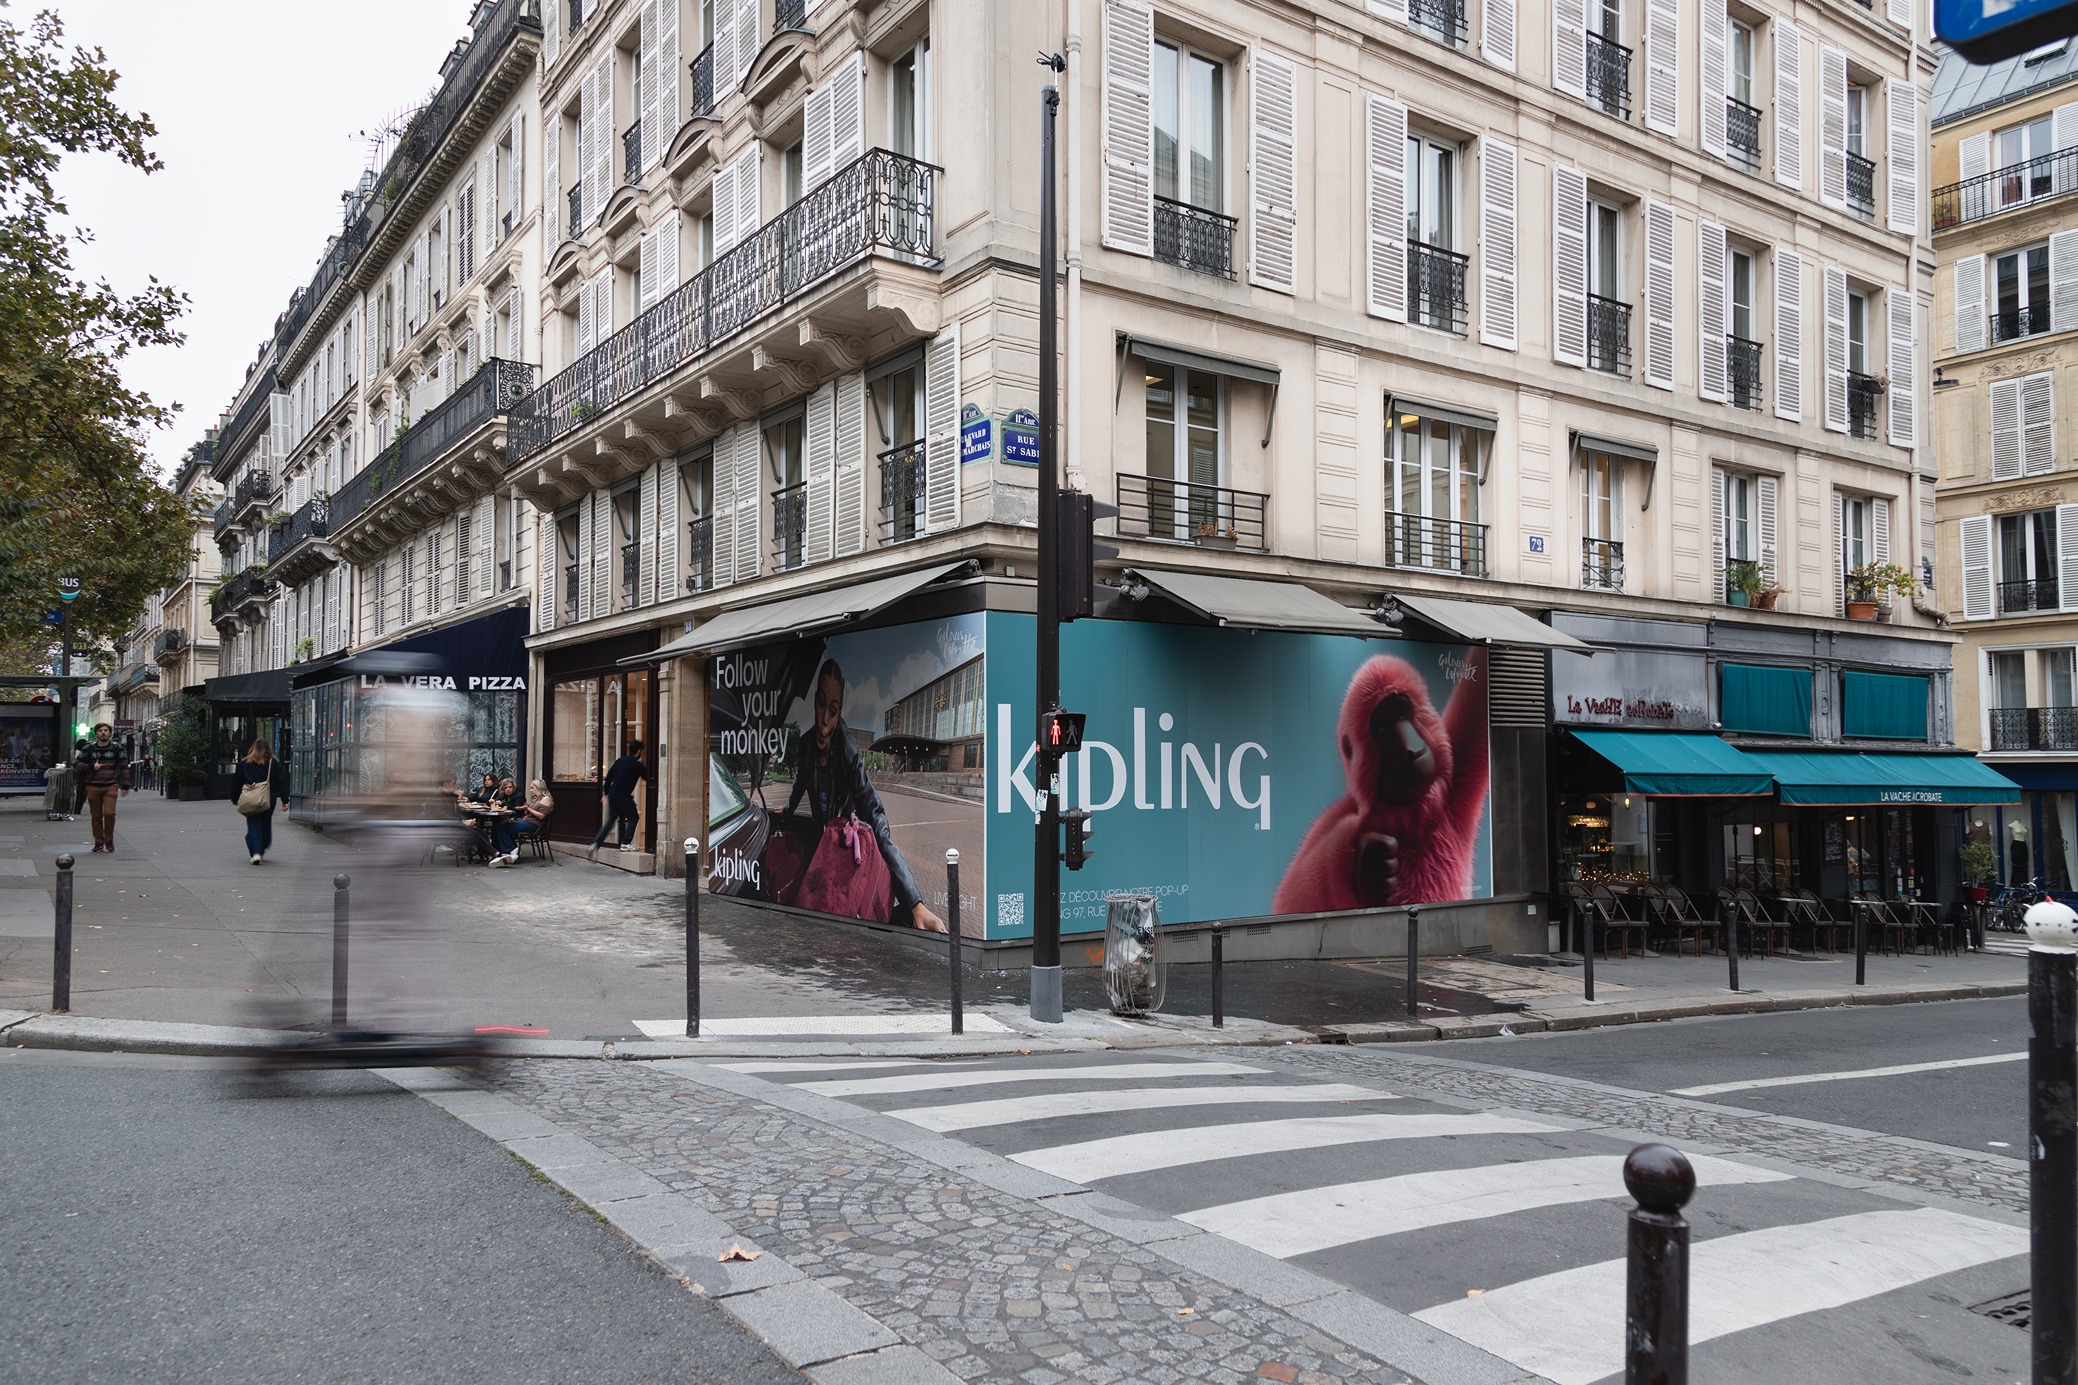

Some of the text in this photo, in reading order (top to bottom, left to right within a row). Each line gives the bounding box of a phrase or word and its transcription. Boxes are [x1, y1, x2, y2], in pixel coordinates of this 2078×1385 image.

[961, 428, 986, 443] ULEVARD
[1017, 435, 1035, 446] RUE
[962, 440, 991, 456] MARCHAIS
[1020, 448, 1039, 458] SABI
[1531, 538, 1542, 551] 72
[58, 577, 79, 587] BUS
[716, 653, 769, 690] Follow
[361, 674, 527, 690] LA VERA PIZZA
[741, 689, 781, 727] your
[721, 720, 789, 763] monkey
[1880, 791, 1942, 802] LA VACHE ACROBATE
[1155, 884, 1189, 898] POP-UP
[959, 894, 977, 911] GHT
[1087, 905, 1107, 918] RUE
